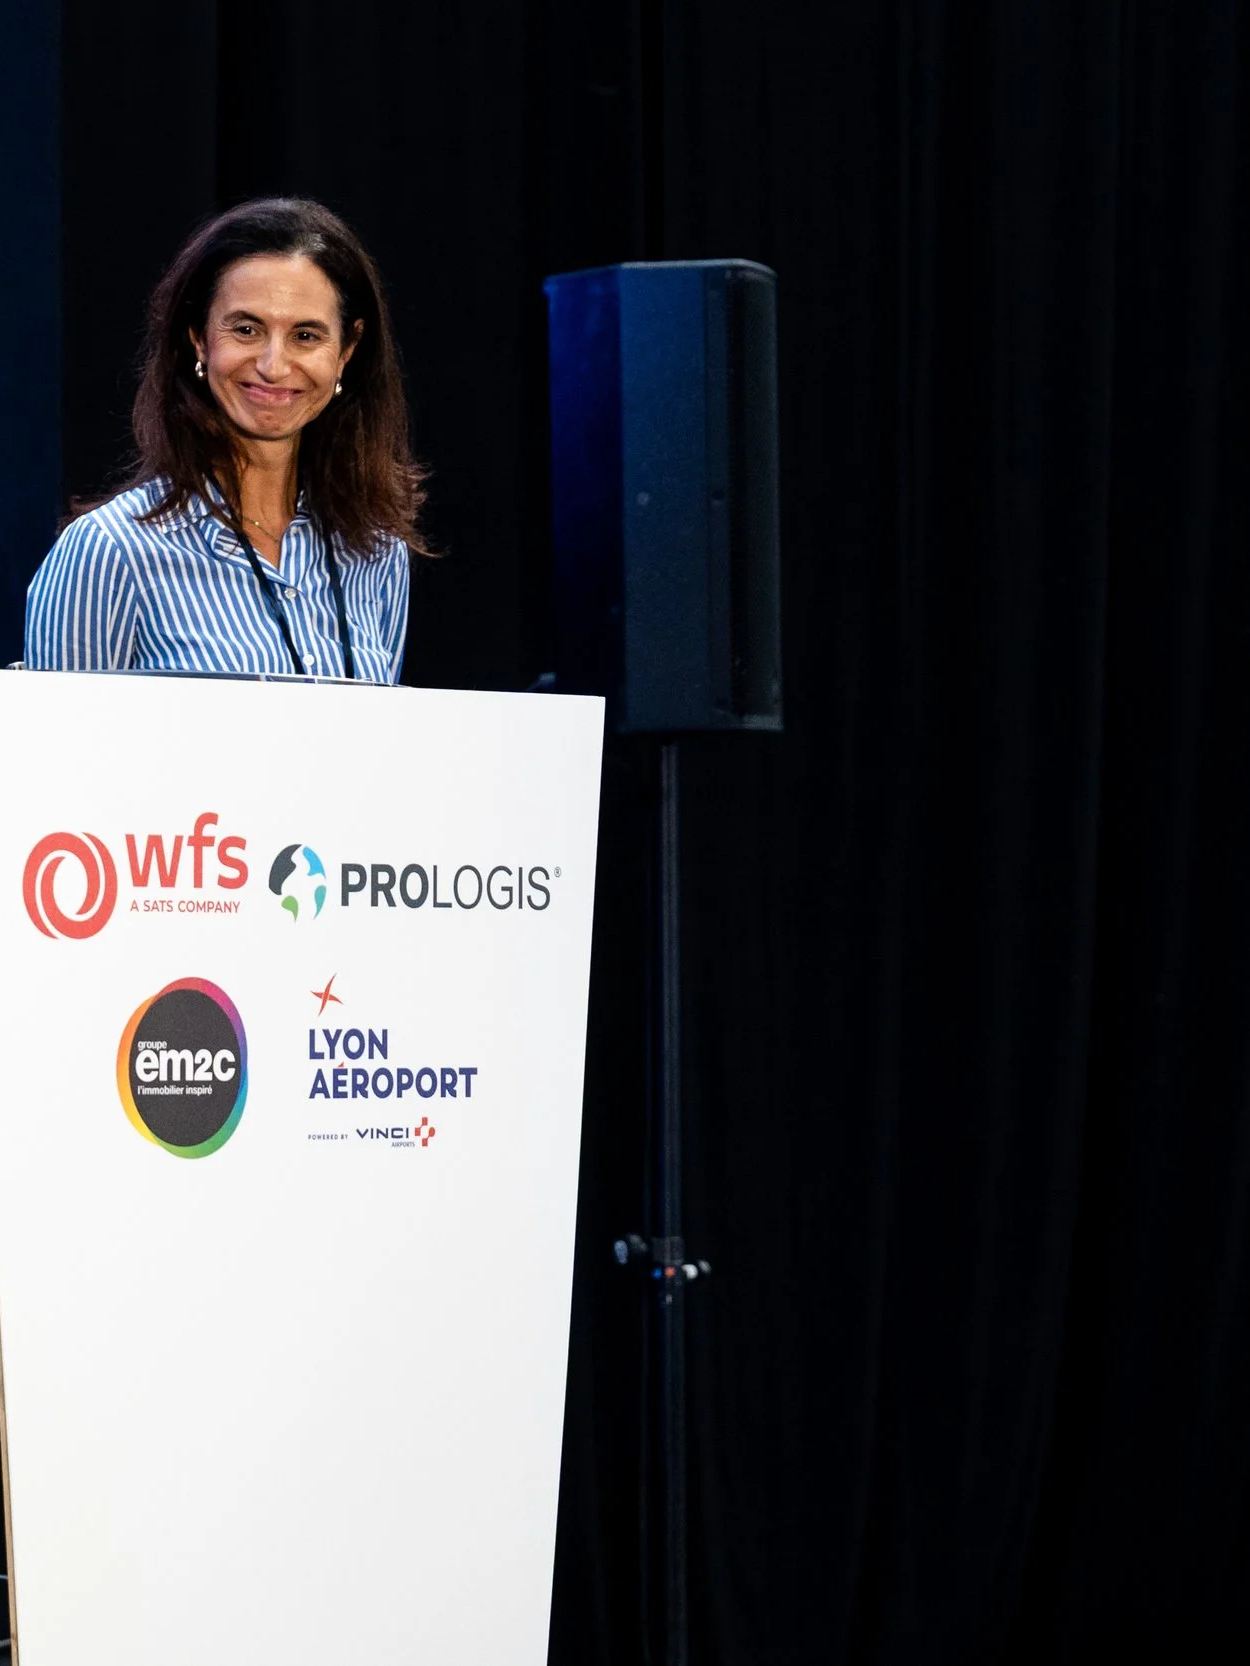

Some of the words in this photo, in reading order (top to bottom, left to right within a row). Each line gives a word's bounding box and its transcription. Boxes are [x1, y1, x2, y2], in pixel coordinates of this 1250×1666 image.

[125, 812, 249, 889] wfs
[130, 900, 139, 912] A
[143, 900, 173, 912] SATS
[178, 901, 240, 913] COMPANY
[137, 1041, 168, 1050] groupe
[309, 1028, 388, 1060] LYON
[135, 1049, 236, 1082] em2c
[137, 1085, 184, 1095] l'immobilier
[186, 1085, 212, 1096] inspiré
[309, 1062, 478, 1099] AÉROPORT
[356, 1127, 409, 1139] VINCI
